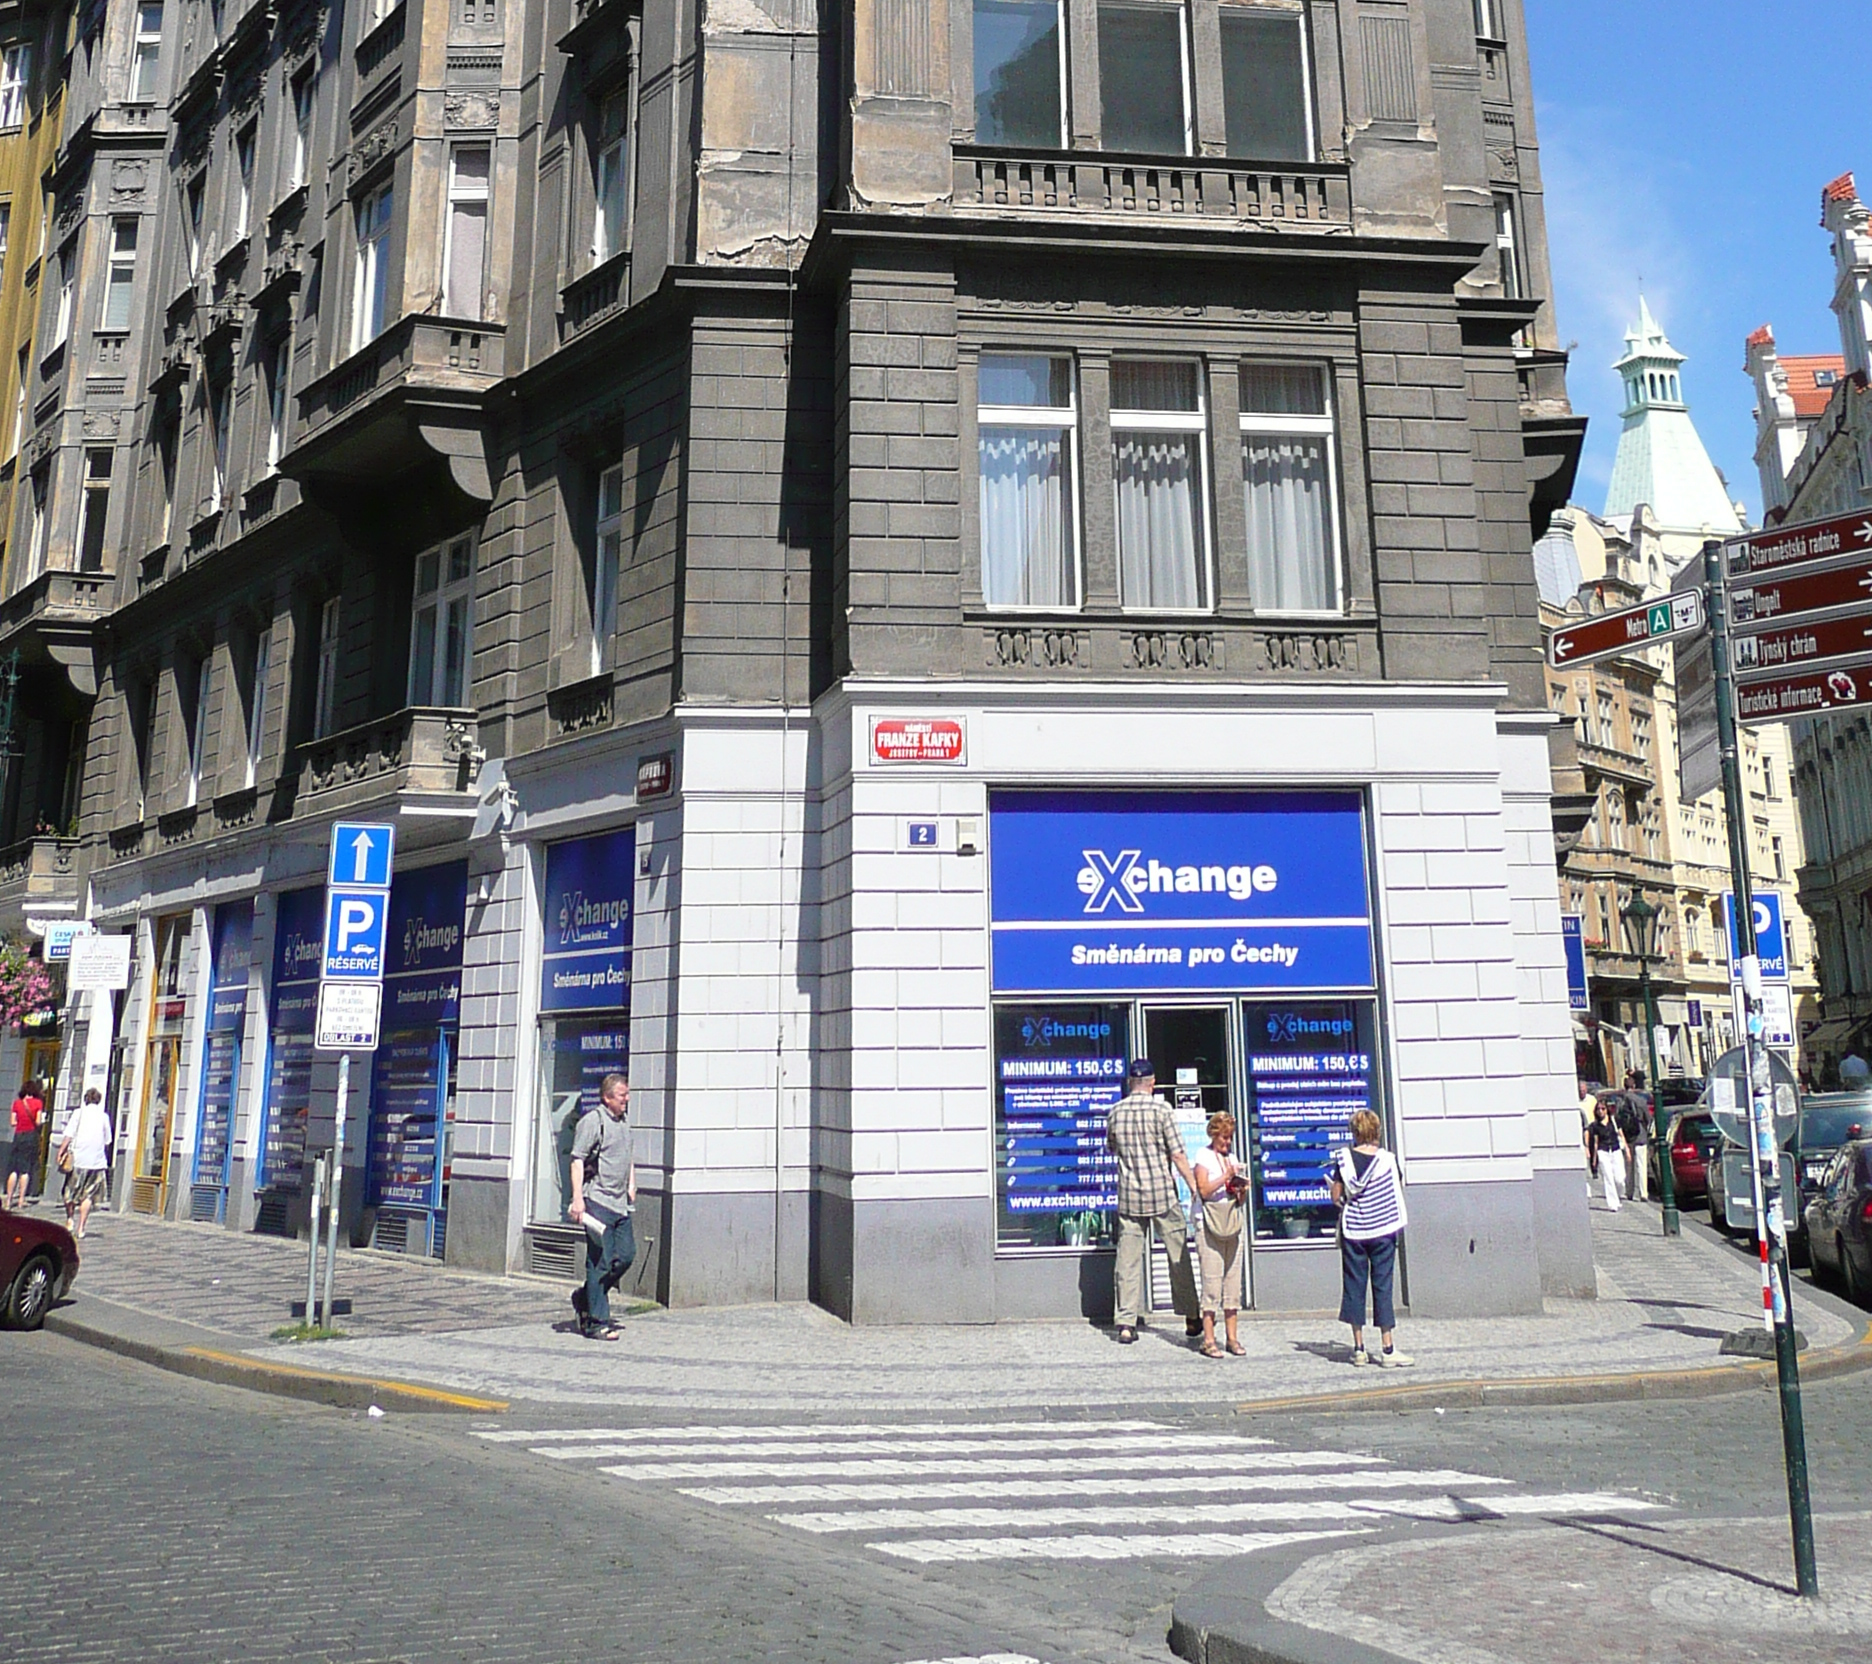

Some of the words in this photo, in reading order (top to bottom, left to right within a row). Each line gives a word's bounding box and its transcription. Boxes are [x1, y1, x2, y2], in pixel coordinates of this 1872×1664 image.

[1751, 535, 1807, 566] Staroměstská
[1808, 529, 1840, 554] radnice
[1755, 588, 1781, 617] Ungelt
[1626, 617, 1648, 638] Metro
[1653, 609, 1668, 632] A
[1759, 636, 1788, 666] Týnský
[1790, 632, 1817, 656] chrám
[1739, 686, 1778, 714] Turistické
[1779, 684, 1822, 709] informace
[877, 732, 920, 748] FRANZE
[922, 732, 959, 748] KAFKY
[904, 722, 932, 733] NÁMĚSTÍ
[918, 826, 928, 842] 2
[1076, 849, 1278, 913] eXchange
[337, 900, 375, 952] P
[559, 890, 629, 944] eXchange
[404, 917, 459, 966] eXchange
[1071, 943, 1182, 965] Směnárna
[1188, 947, 1226, 968] pro
[1230, 938, 1299, 967] Čechy
[327, 955, 379, 971] RÉSERVÉ
[553, 970, 591, 988] Směnárna
[591, 972, 605, 990] pro
[1022, 1017, 1111, 1046] eXchange
[1267, 1013, 1353, 1042] eXchange
[1003, 1061, 1072, 1076] MINIMUM:
[1252, 1056, 1319, 1071] MINIMUM:
